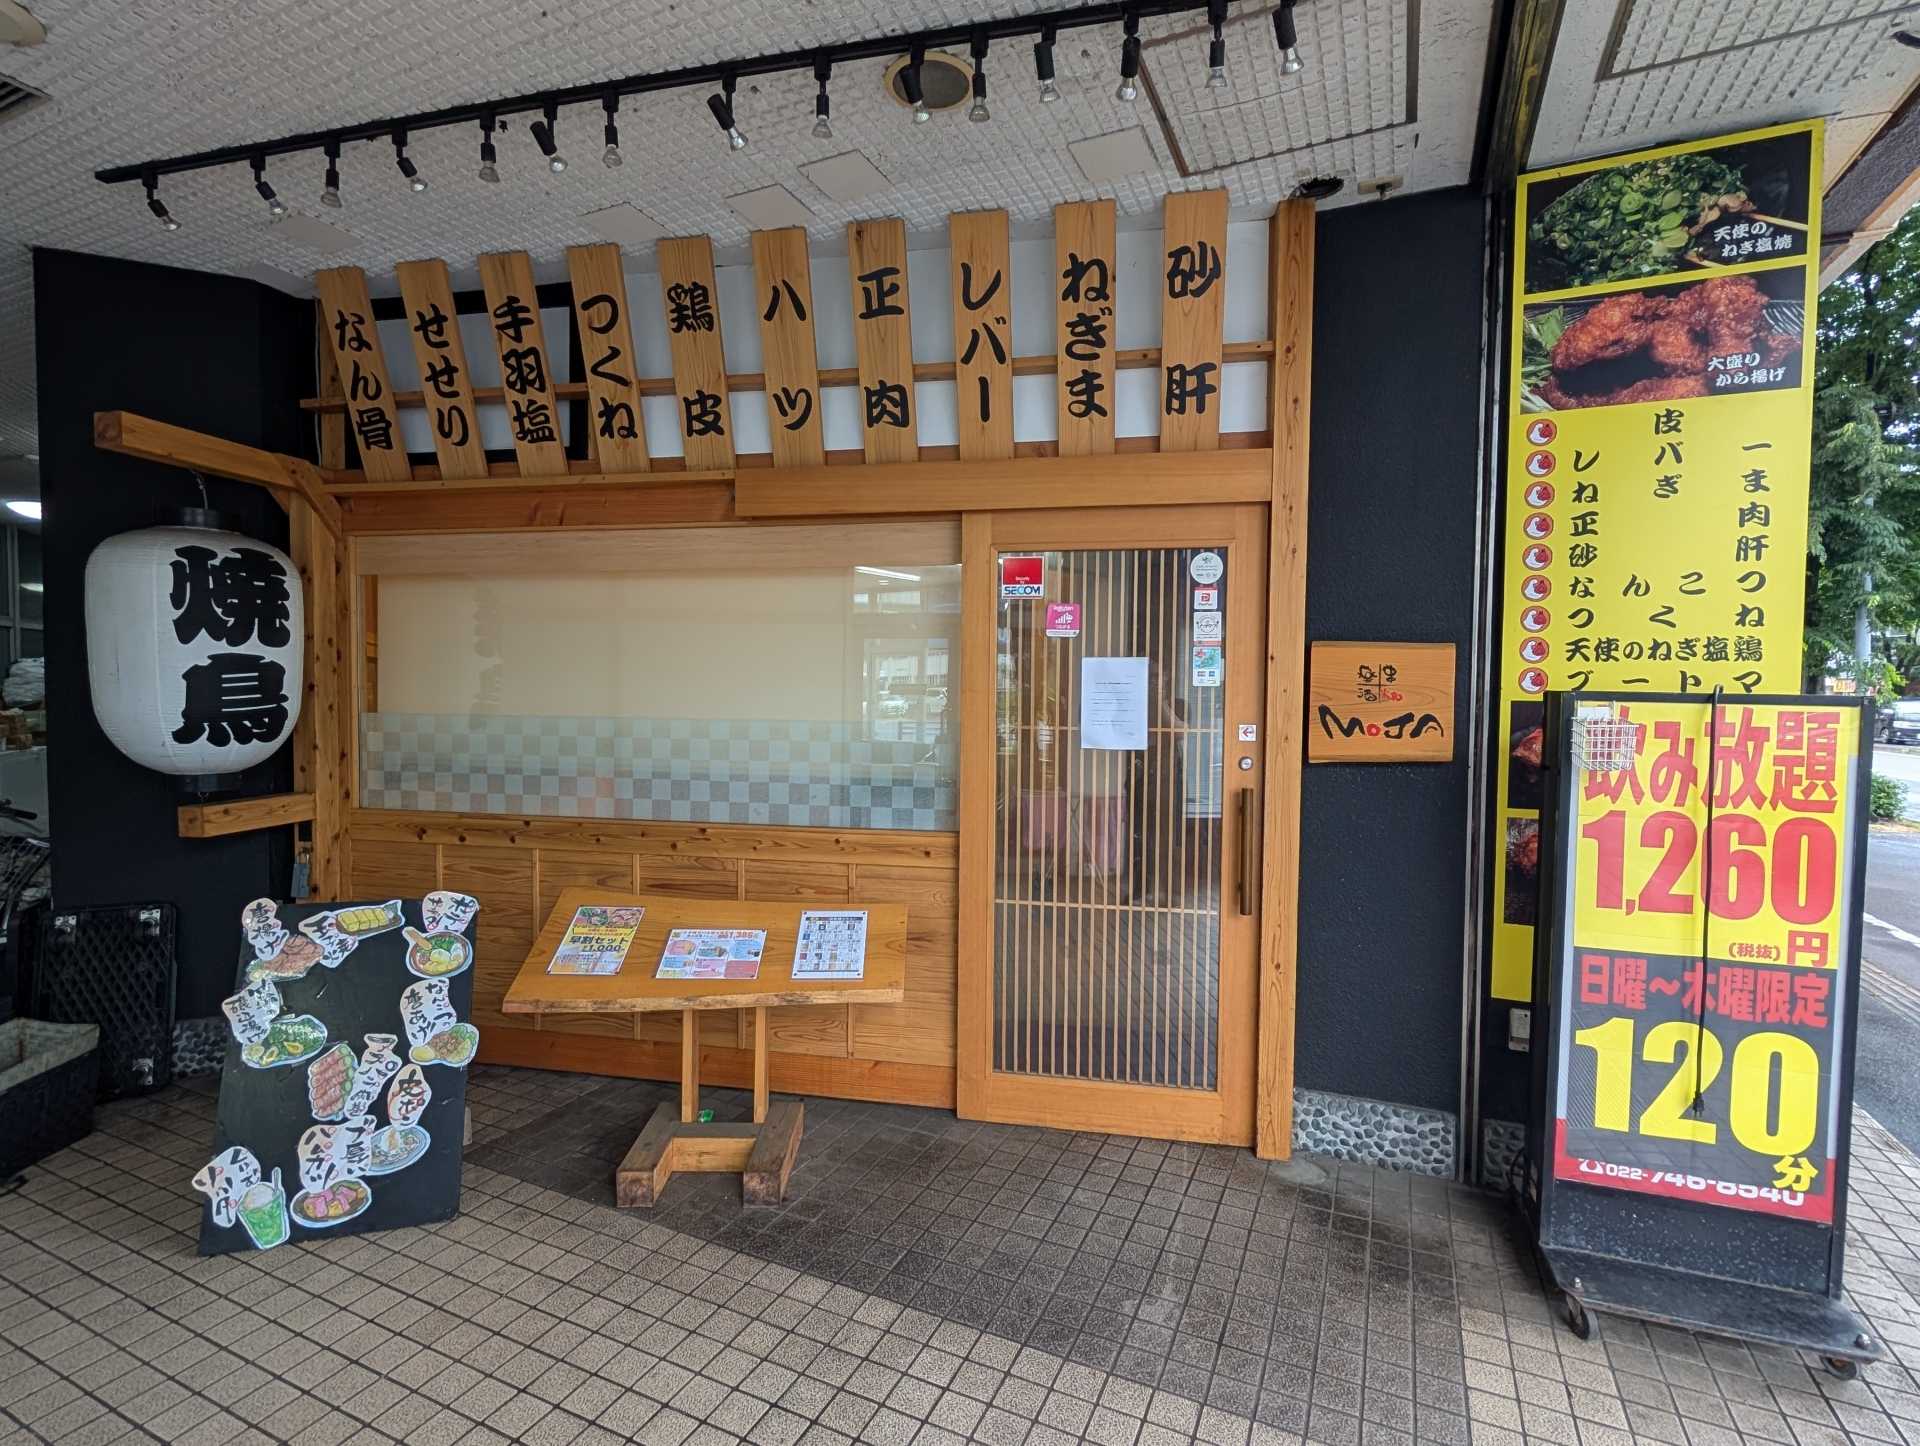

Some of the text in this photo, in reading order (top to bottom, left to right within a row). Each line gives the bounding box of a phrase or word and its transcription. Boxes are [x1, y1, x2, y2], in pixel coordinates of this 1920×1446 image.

[1713, 221, 1768, 242] 天使の
[1721, 234, 1793, 259] ねぎ塩焼
[334, 309, 394, 450] なん骨
[413, 303, 471, 447] せせり
[493, 295, 557, 445] 手羽塩
[580, 293, 639, 439] つくね
[666, 281, 725, 437] 鶏皮
[763, 279, 812, 431] ハツ
[858, 266, 911, 430] 正肉
[960, 262, 1008, 422] レバー
[1061, 252, 1113, 419] ねぎま
[1165, 240, 1222, 417] 砂肝
[1707, 352, 1761, 372] 大盛り
[1715, 366, 1786, 388] から揚げ
[1653, 408, 1685, 436] 皮
[169, 545, 291, 748] 焼鳥
[1004, 586, 1041, 595] SECOM
[1565, 635, 1764, 664] 天使のねぎ塩鶏
[1569, 571, 1767, 600] なんこつ
[1584, 704, 1841, 814] 飲み放題
[1582, 810, 1837, 925] 1,260
[1787, 930, 1829, 968] 円
[1575, 1016, 1820, 1157] 120
[1772, 1155, 1819, 1192] 分
